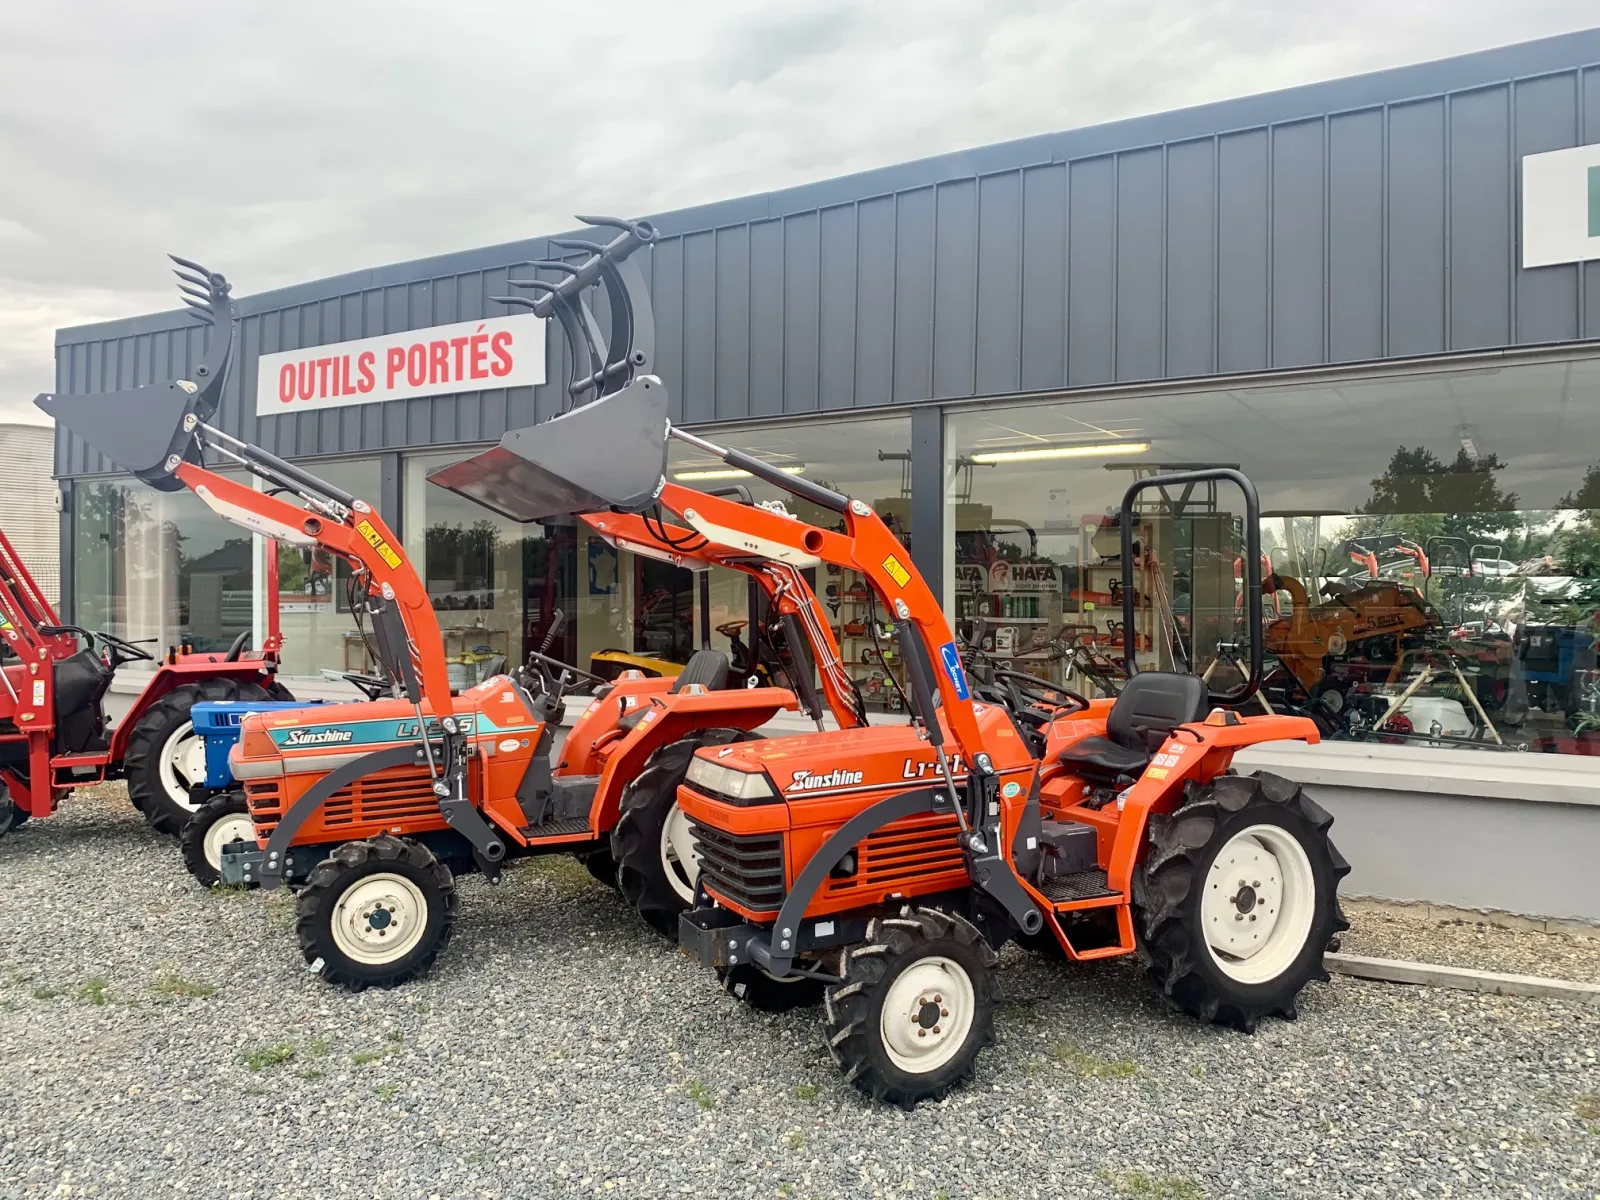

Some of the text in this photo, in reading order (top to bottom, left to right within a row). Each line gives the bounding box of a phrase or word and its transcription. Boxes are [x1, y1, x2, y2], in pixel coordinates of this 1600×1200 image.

[279, 324, 513, 403] OUTILS PORTÉS
[955, 567, 983, 581] AFA
[1012, 566, 1057, 581] HAFA
[282, 728, 353, 746] Sunshine
[902, 753, 969, 778] L1-21
[783, 768, 864, 792] Sunshine
